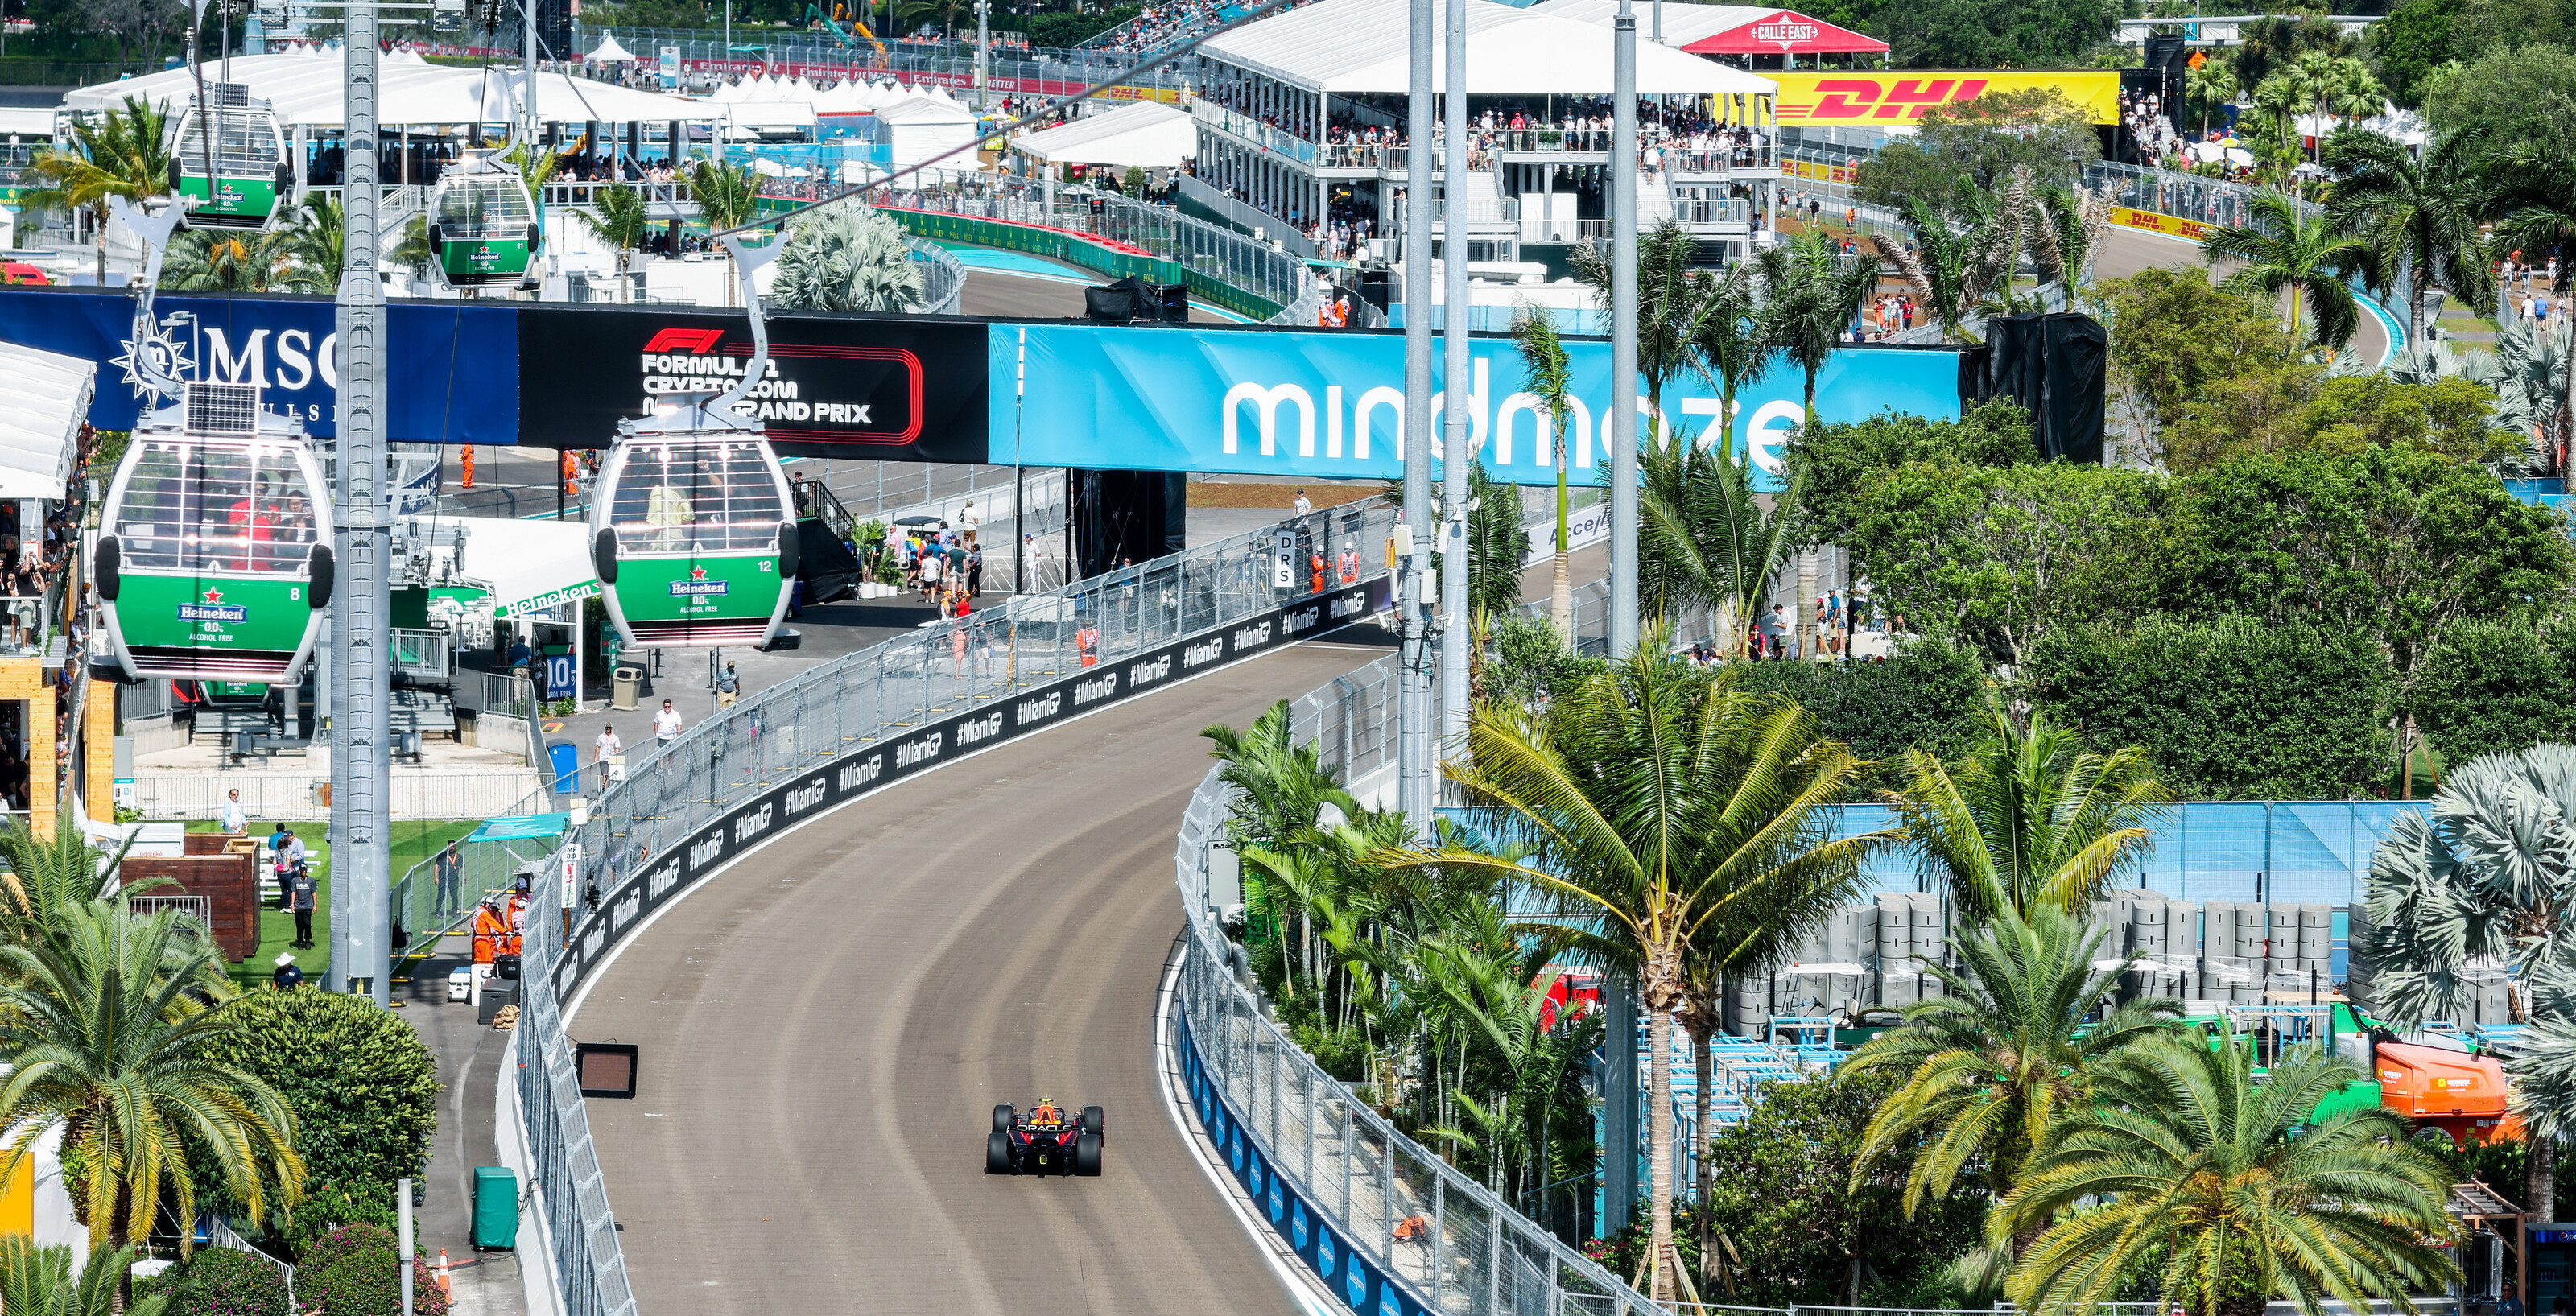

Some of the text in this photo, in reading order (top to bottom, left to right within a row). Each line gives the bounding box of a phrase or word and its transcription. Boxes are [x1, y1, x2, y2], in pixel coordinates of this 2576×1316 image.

[1757, 26, 1812, 39] CALLE EAST
[913, 74, 966, 85] Emirates
[1108, 88, 1143, 99] DHL
[2131, 212, 2160, 229] DHL
[766, 359, 779, 377] 1
[814, 403, 872, 423] PRIX
[758, 560, 772, 572] 12
[290, 588, 300, 600] 8
[506, 584, 592, 616] Heineken
[671, 582, 726, 594] Heineken
[180, 606, 244, 621] Heineken
[1282, 605, 1319, 636] #MiamiGP
[1330, 591, 1365, 621] #MiamiGP
[188, 633, 233, 642] ALCOHOL FREE
[1234, 621, 1271, 652] #MiamiGP
[1183, 637, 1223, 669] #MiamiGP
[1129, 654, 1171, 687] #MiamiGP
[1075, 672, 1117, 706] #MiamiGP
[1017, 691, 1061, 726] #MiamiGP
[956, 711, 1003, 747] #MiamiGP
[896, 731, 943, 769] #MiamiGP
[839, 753, 882, 793] #MiamiGP
[785, 777, 826, 817] #MiamiGP
[734, 802, 773, 844] #MiamiGP
[689, 828, 724, 873] #MiamiGP
[649, 856, 680, 902] #MiamiGP
[1320, 1244, 1334, 1264] salesforce
[1349, 1272, 1365, 1293] salesforce
